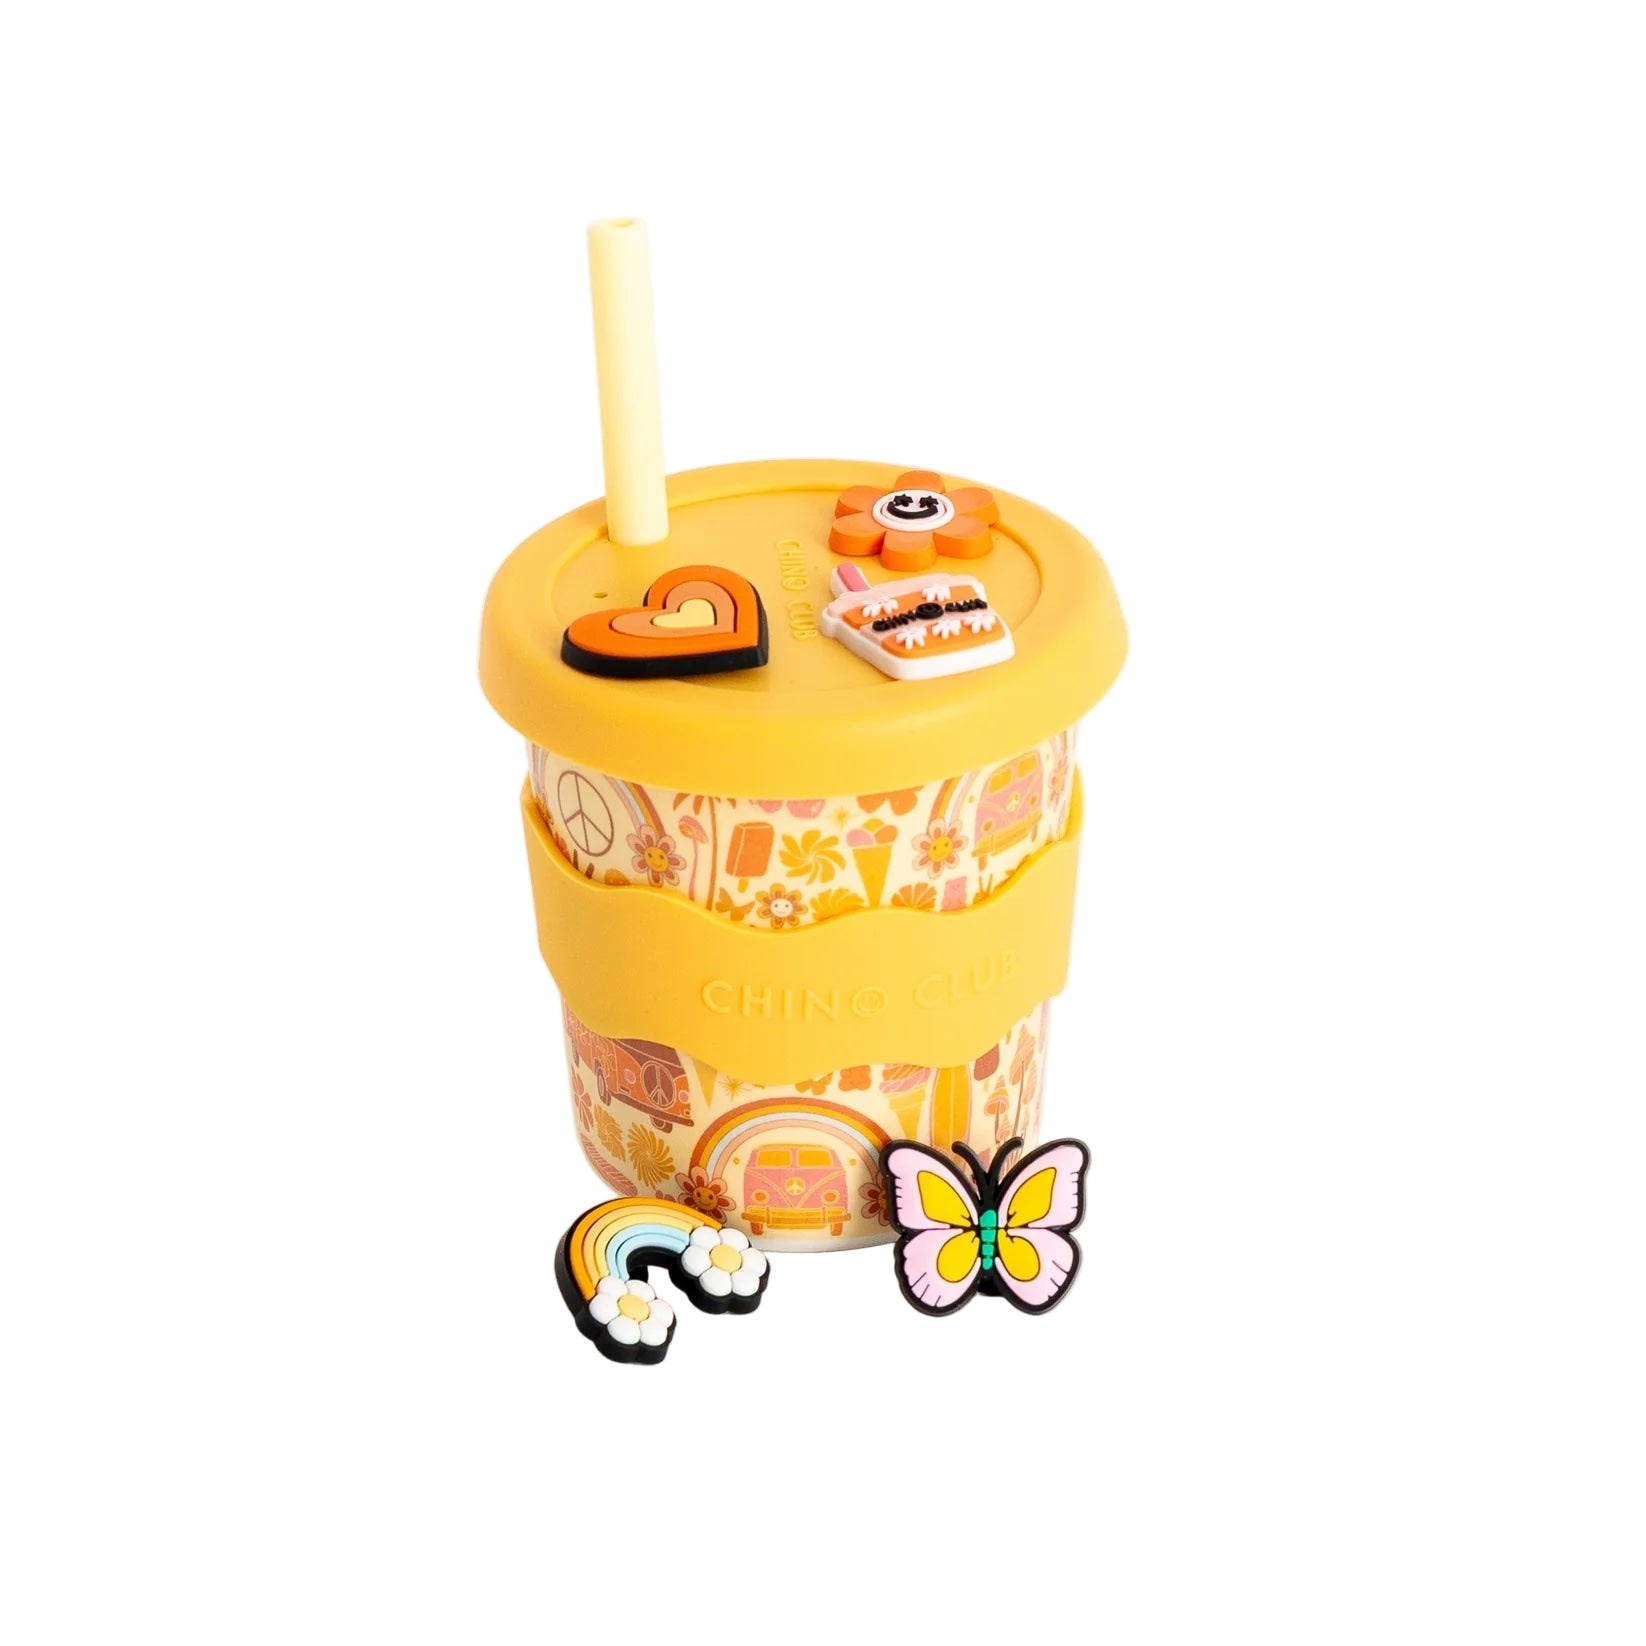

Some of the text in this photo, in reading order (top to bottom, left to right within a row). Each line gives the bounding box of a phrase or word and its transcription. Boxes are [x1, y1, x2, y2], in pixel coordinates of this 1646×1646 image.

[779, 539, 818, 640] CHINO CLUB
[914, 950, 1017, 1010] CLUB
